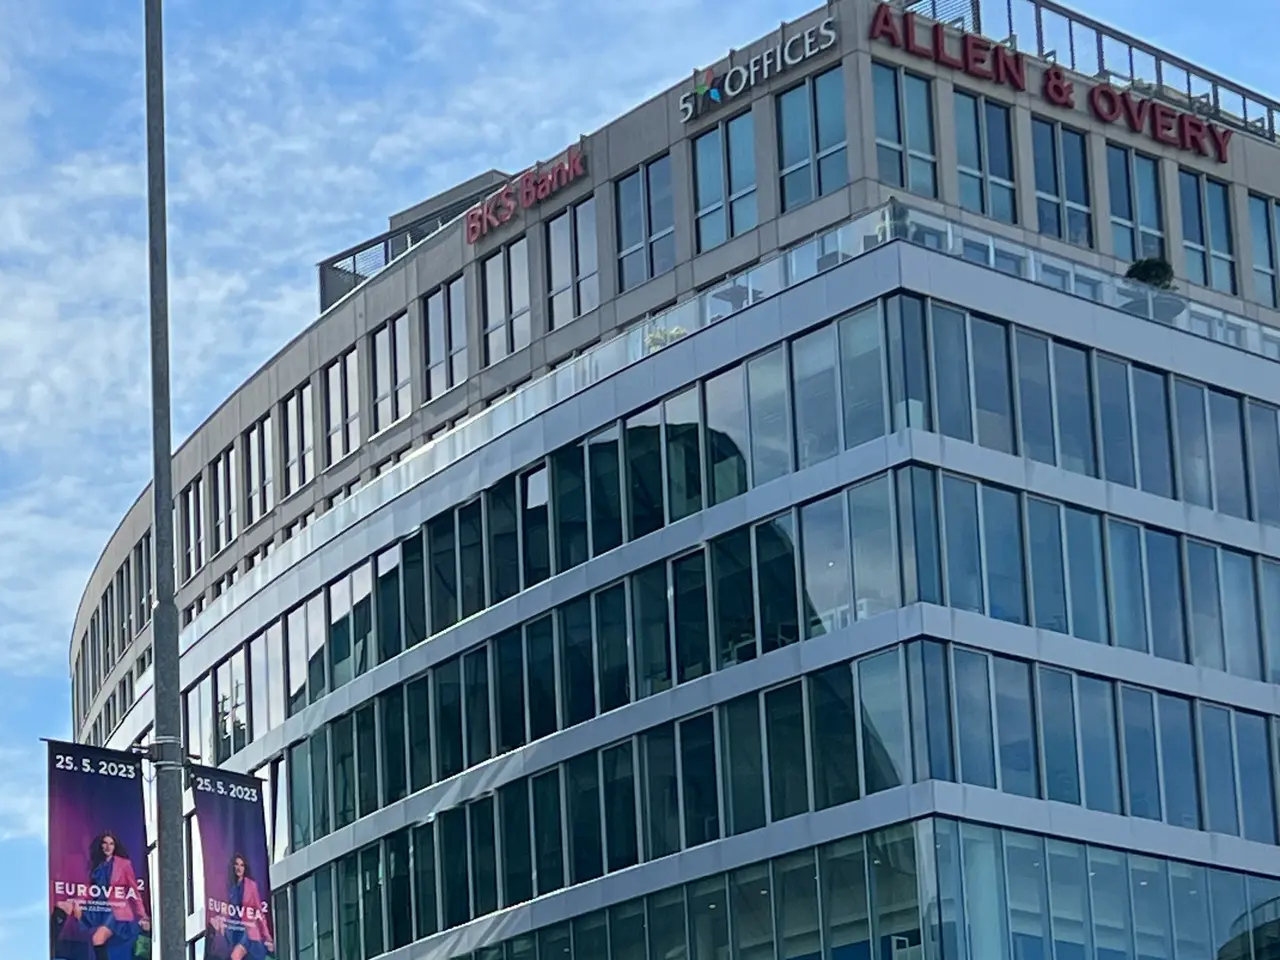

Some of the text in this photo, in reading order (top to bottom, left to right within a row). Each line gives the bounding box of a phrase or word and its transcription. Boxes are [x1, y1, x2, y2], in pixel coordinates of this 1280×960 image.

[724, 16, 838, 97] OFFICES
[869, 4, 1234, 163] ALLEN & OVERY
[465, 144, 588, 245] BKS Bank
[98, 760, 136, 779] 2023
[229, 783, 258, 802] 2023
